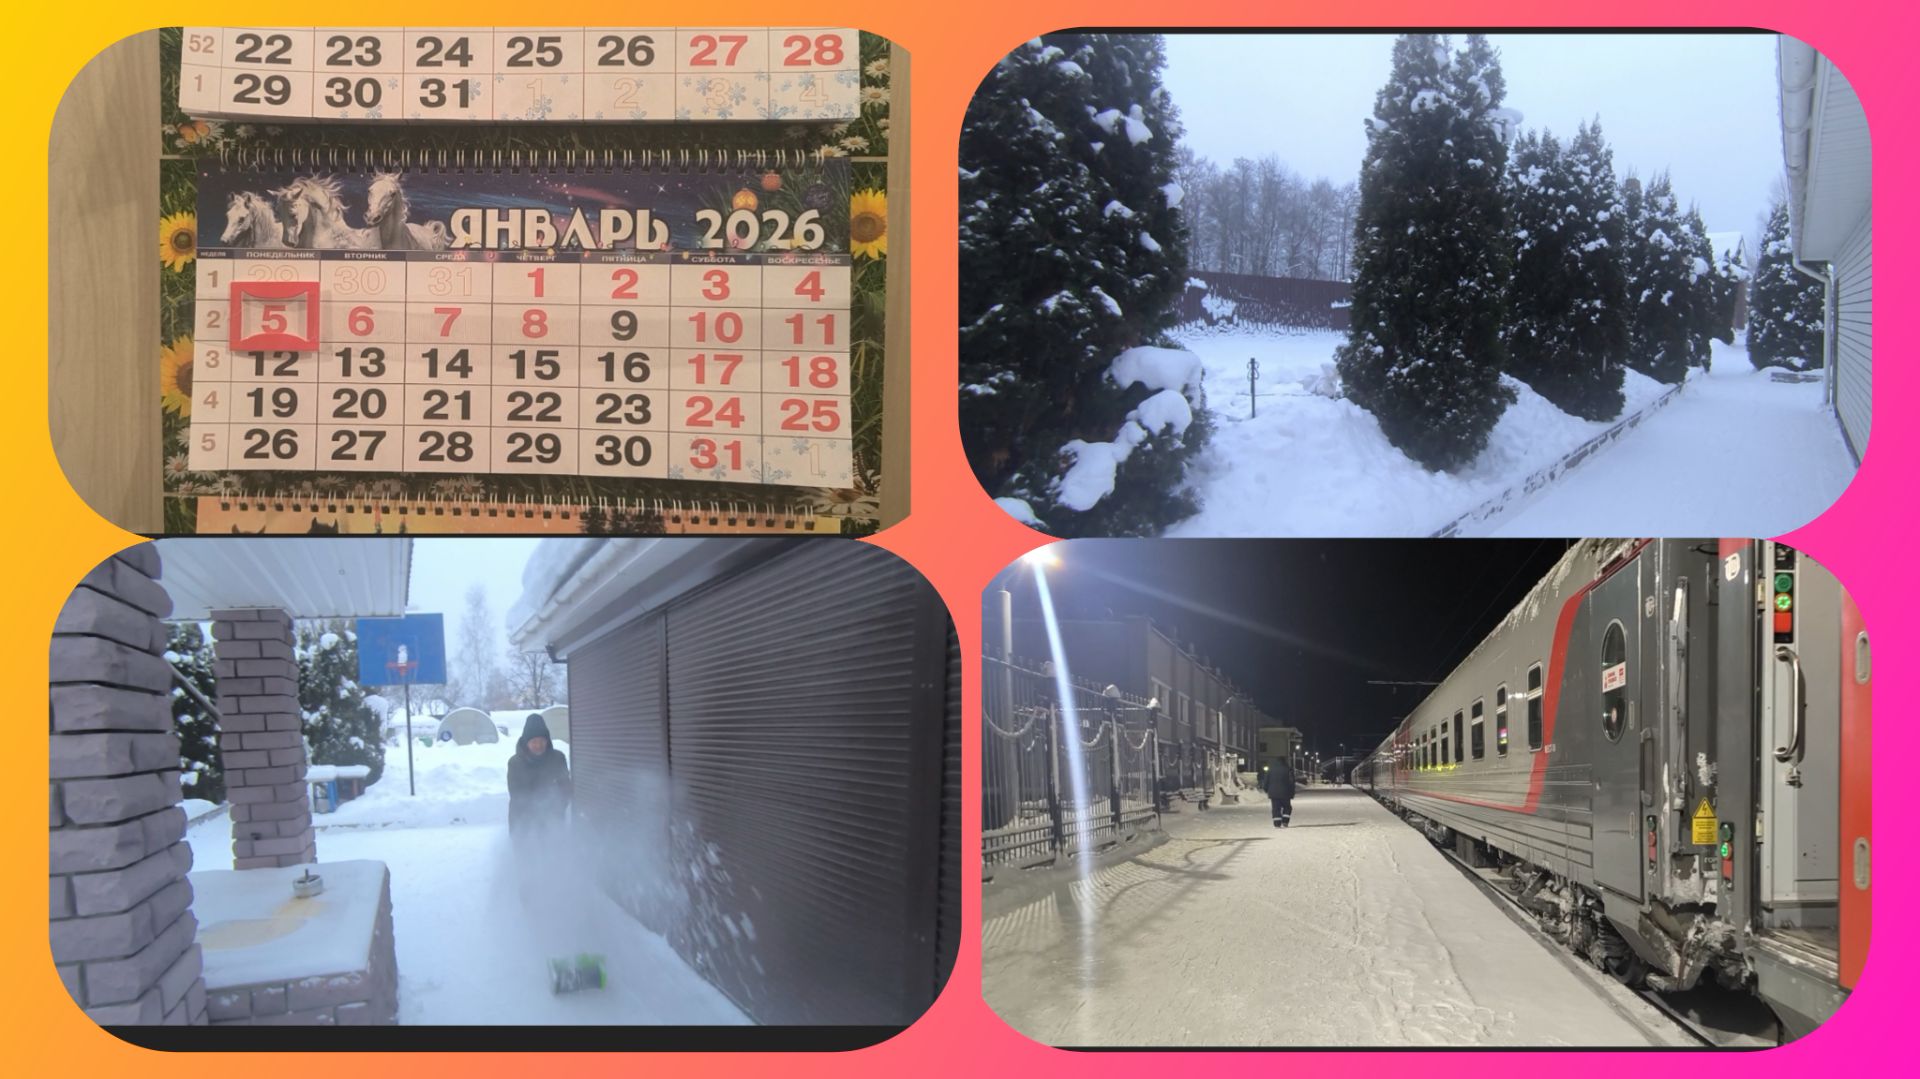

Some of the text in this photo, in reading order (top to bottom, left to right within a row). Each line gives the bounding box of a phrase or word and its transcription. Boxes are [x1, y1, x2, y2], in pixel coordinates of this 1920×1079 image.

[189, 34, 844, 67] 52 22 23 24 25 26 27 28
[194, 74, 203, 92] 1
[233, 73, 291, 105] 29
[324, 77, 382, 108] 30
[419, 78, 470, 108] 31
[614, 79, 639, 109] 2
[450, 207, 825, 250] ЯНВАРЬ 2026
[344, 252, 387, 260] ВТОРНИК
[208, 270, 218, 288] 1
[333, 265, 386, 295] 30
[428, 266, 472, 296] 31
[527, 267, 544, 297] 1
[611, 268, 639, 299] 2
[702, 270, 730, 300] 3
[794, 271, 825, 302] 4
[206, 305, 835, 345] 2 5 6 7 8 9 10 11
[205, 347, 838, 389] 3 12 13 14 15 16 17 18
[203, 387, 841, 432] 4 19 20 21 22 23 24 25
[201, 433, 216, 451] 5
[243, 428, 298, 460] 26
[331, 430, 387, 461] 27
[418, 431, 473, 462] 28
[506, 433, 561, 464] 29
[594, 435, 652, 466] 30
[689, 438, 742, 470] 31
